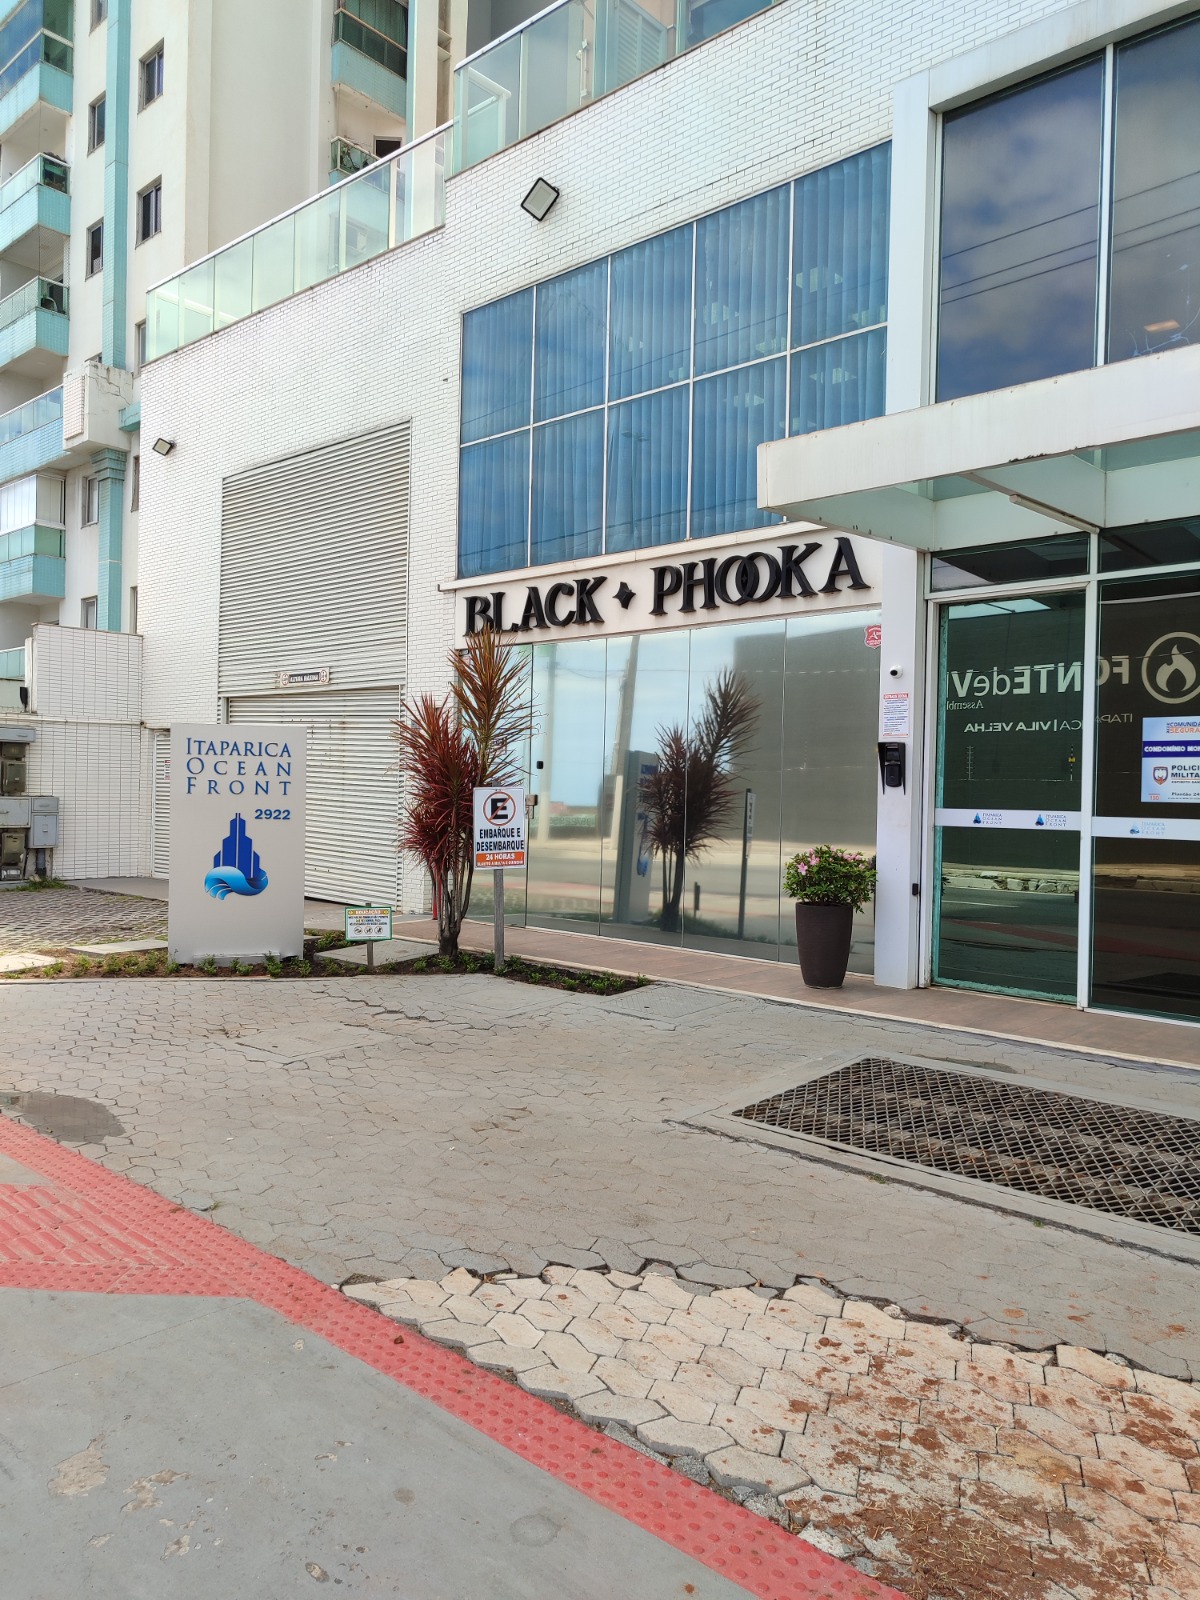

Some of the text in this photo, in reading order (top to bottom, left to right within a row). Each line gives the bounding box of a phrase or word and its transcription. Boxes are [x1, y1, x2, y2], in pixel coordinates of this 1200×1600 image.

[463, 536, 871, 637] BLACK PHOOKA
[186, 737, 291, 758] ITAPARICA
[186, 757, 291, 776] OCEAN
[186, 777, 291, 796] FRONT
[254, 809, 291, 820] 2922
[479, 827, 521, 839] EMBARQUE E
[476, 840, 524, 852] DESEMBARQUE
